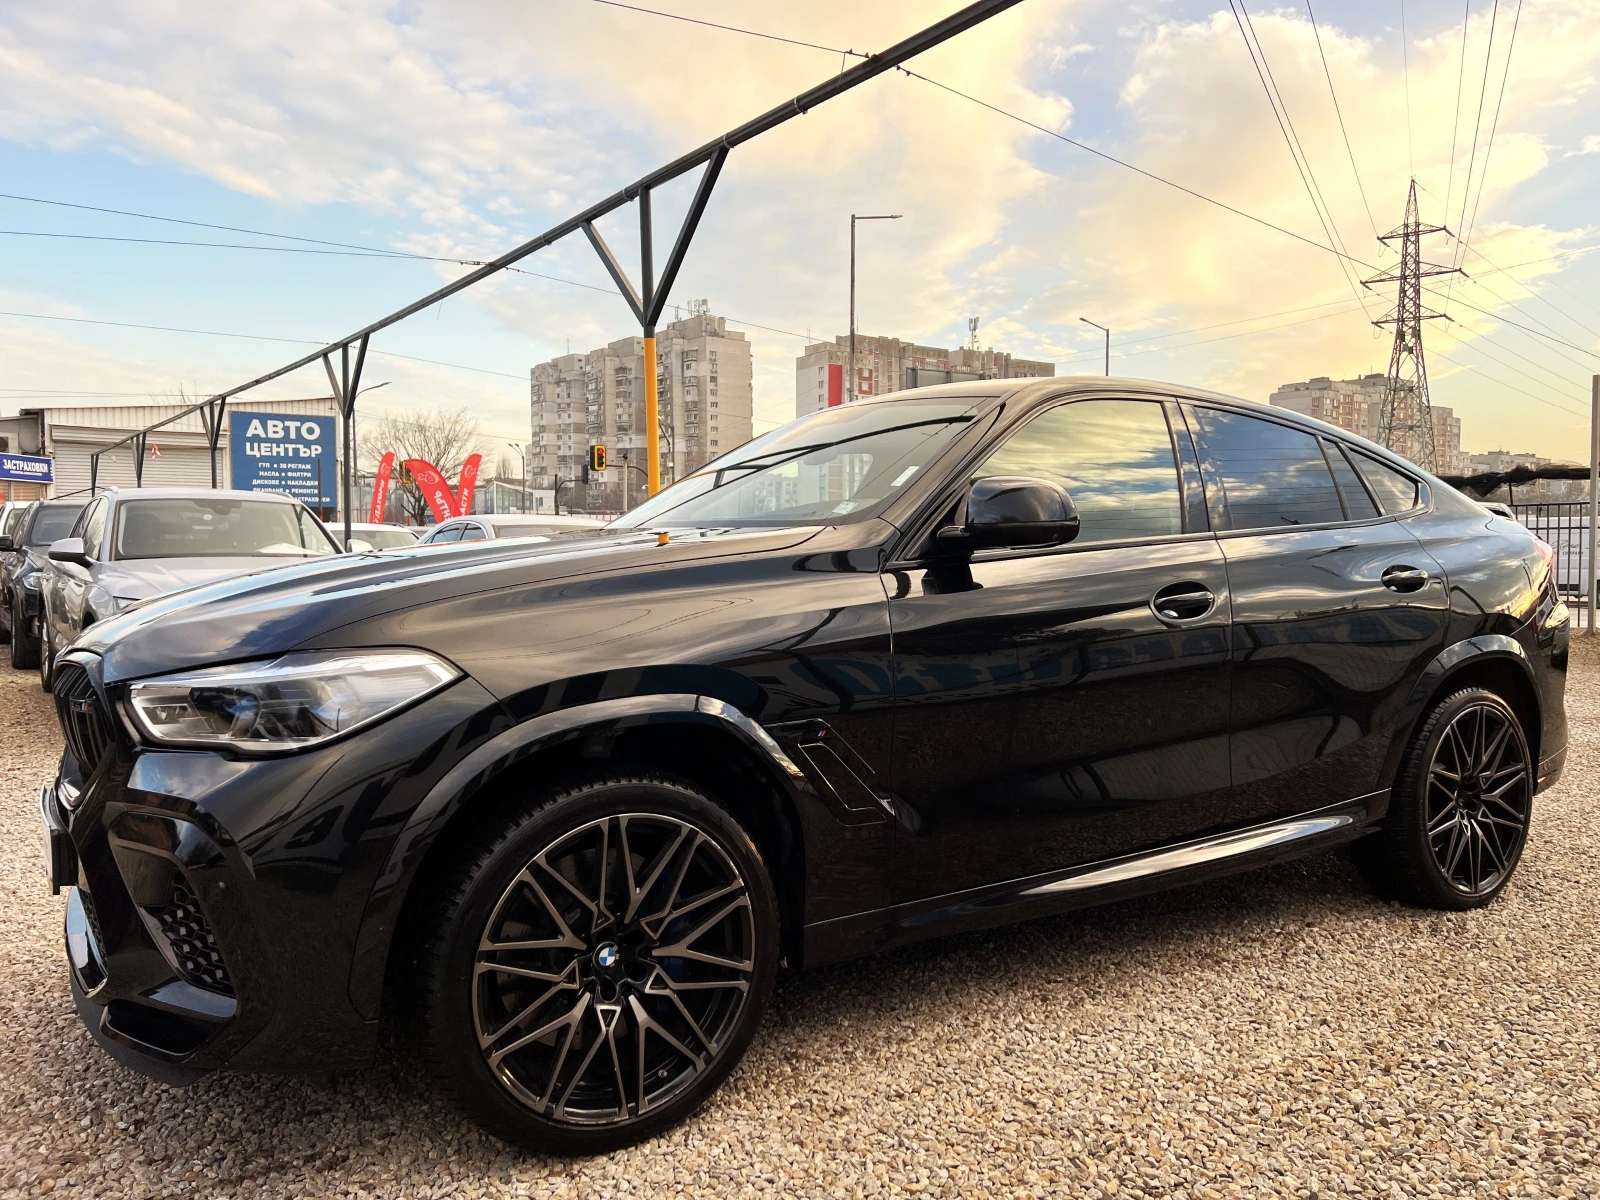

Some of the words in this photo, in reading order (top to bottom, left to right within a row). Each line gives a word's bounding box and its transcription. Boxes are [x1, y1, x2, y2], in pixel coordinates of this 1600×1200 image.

[246, 419, 321, 440] АВТО
[245, 442, 322, 458] ЦЕНТЪР
[3, 459, 48, 473] ЗАСТРАХОВКИ
